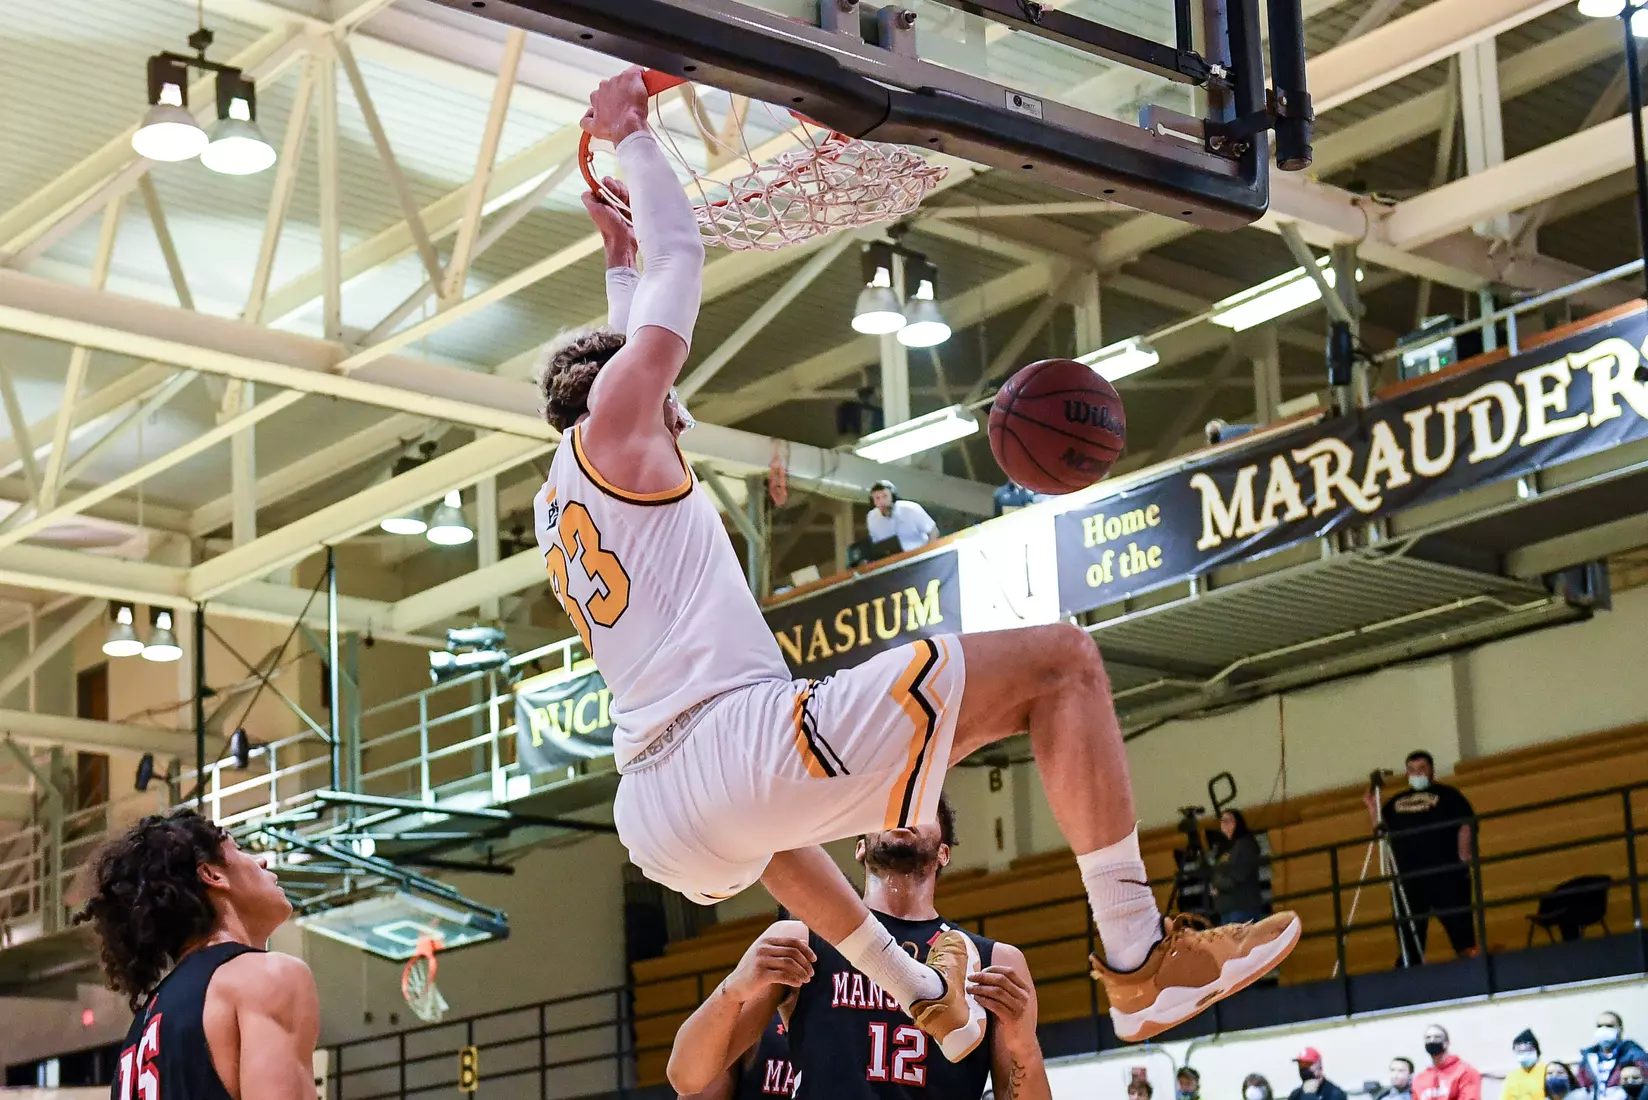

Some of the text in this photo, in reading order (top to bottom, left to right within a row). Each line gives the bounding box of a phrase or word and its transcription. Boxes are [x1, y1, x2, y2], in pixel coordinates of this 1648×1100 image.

[1081, 503, 1161, 548] Home
[1086, 542, 1163, 587] of the
[866, 1022, 928, 1087] 12
